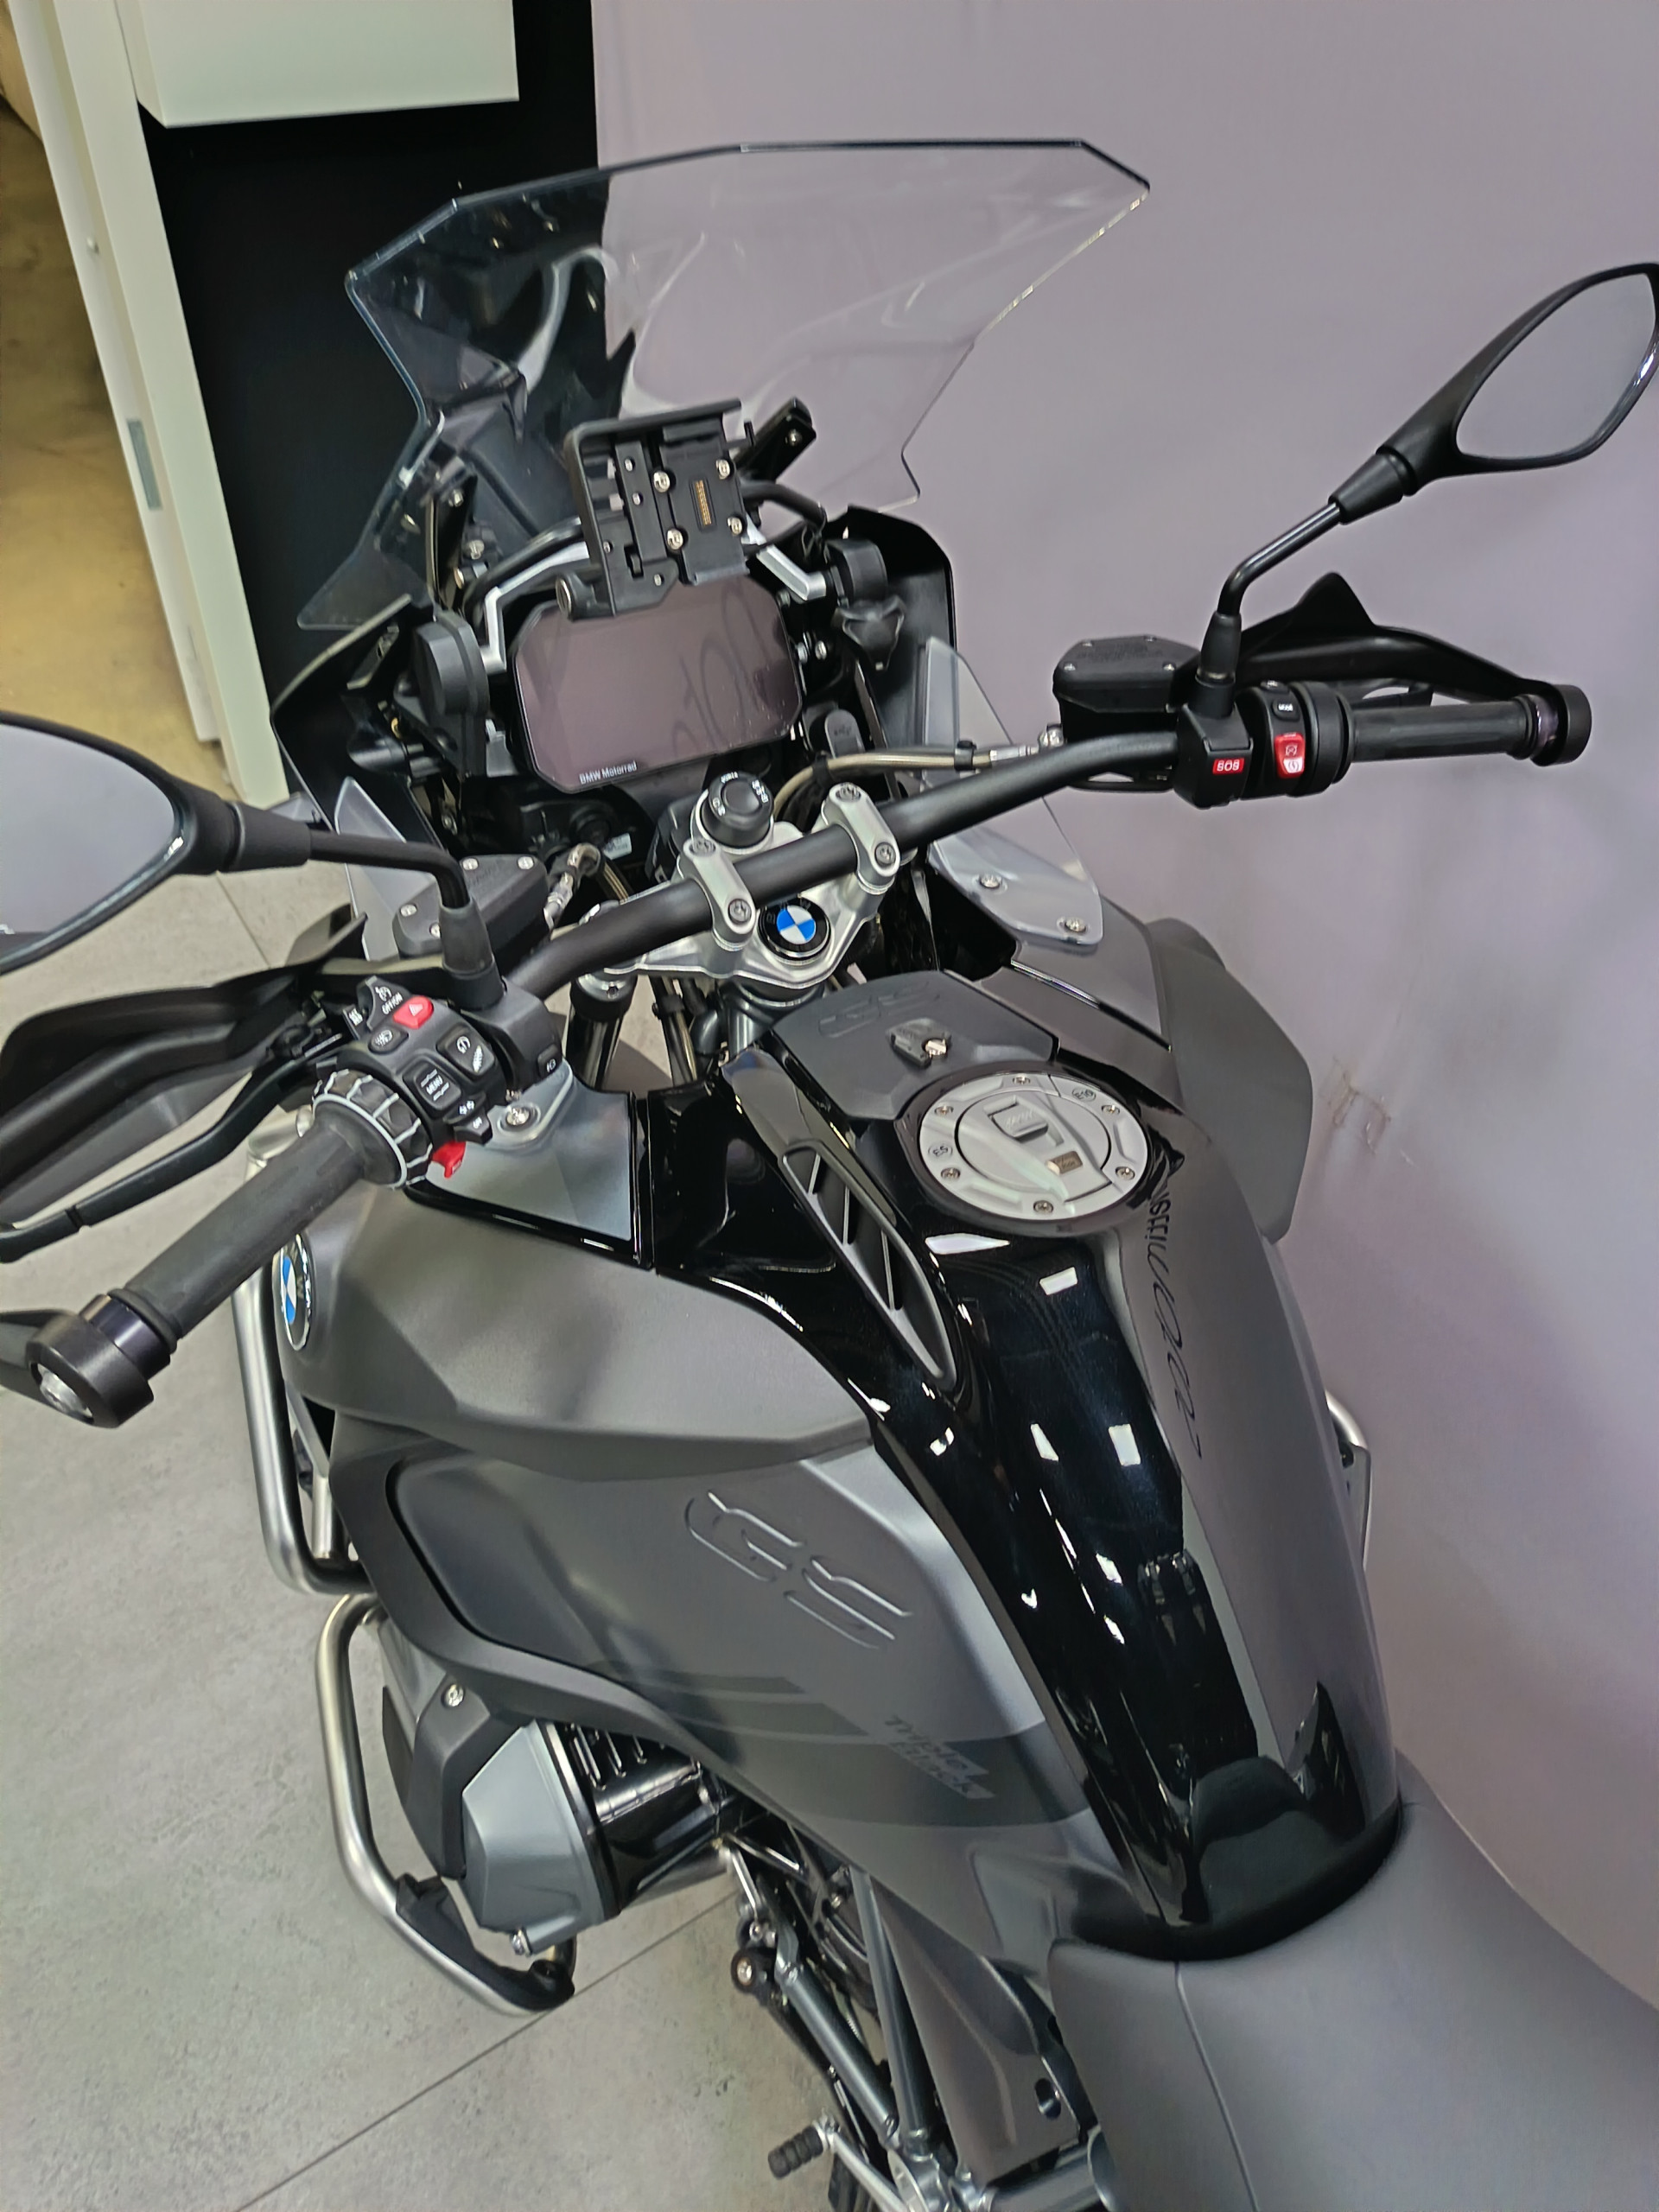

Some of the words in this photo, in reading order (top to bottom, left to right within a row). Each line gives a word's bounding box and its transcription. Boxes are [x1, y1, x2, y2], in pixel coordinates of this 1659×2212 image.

[579, 770, 601, 785] BMW
[601, 760, 638, 778] Motorrad
[1217, 760, 1241, 772] SOS
